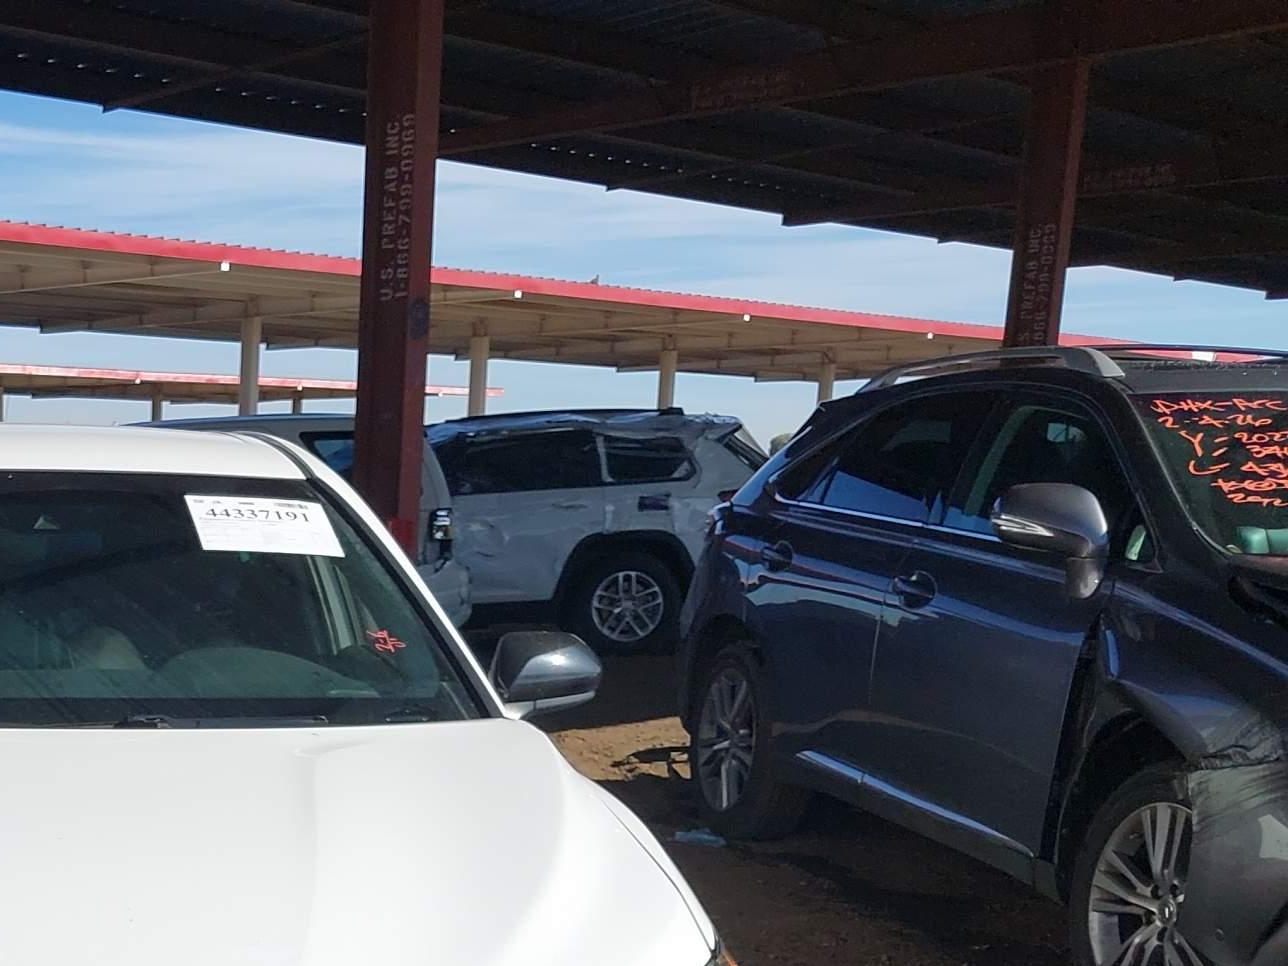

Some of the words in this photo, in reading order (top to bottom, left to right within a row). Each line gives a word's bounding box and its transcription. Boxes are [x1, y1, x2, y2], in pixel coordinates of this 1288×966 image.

[386, 114, 400, 155] INC.
[381, 166, 399, 249] PREFAB
[380, 261, 395, 300] U.S.
[205, 508, 310, 523] 44337191
